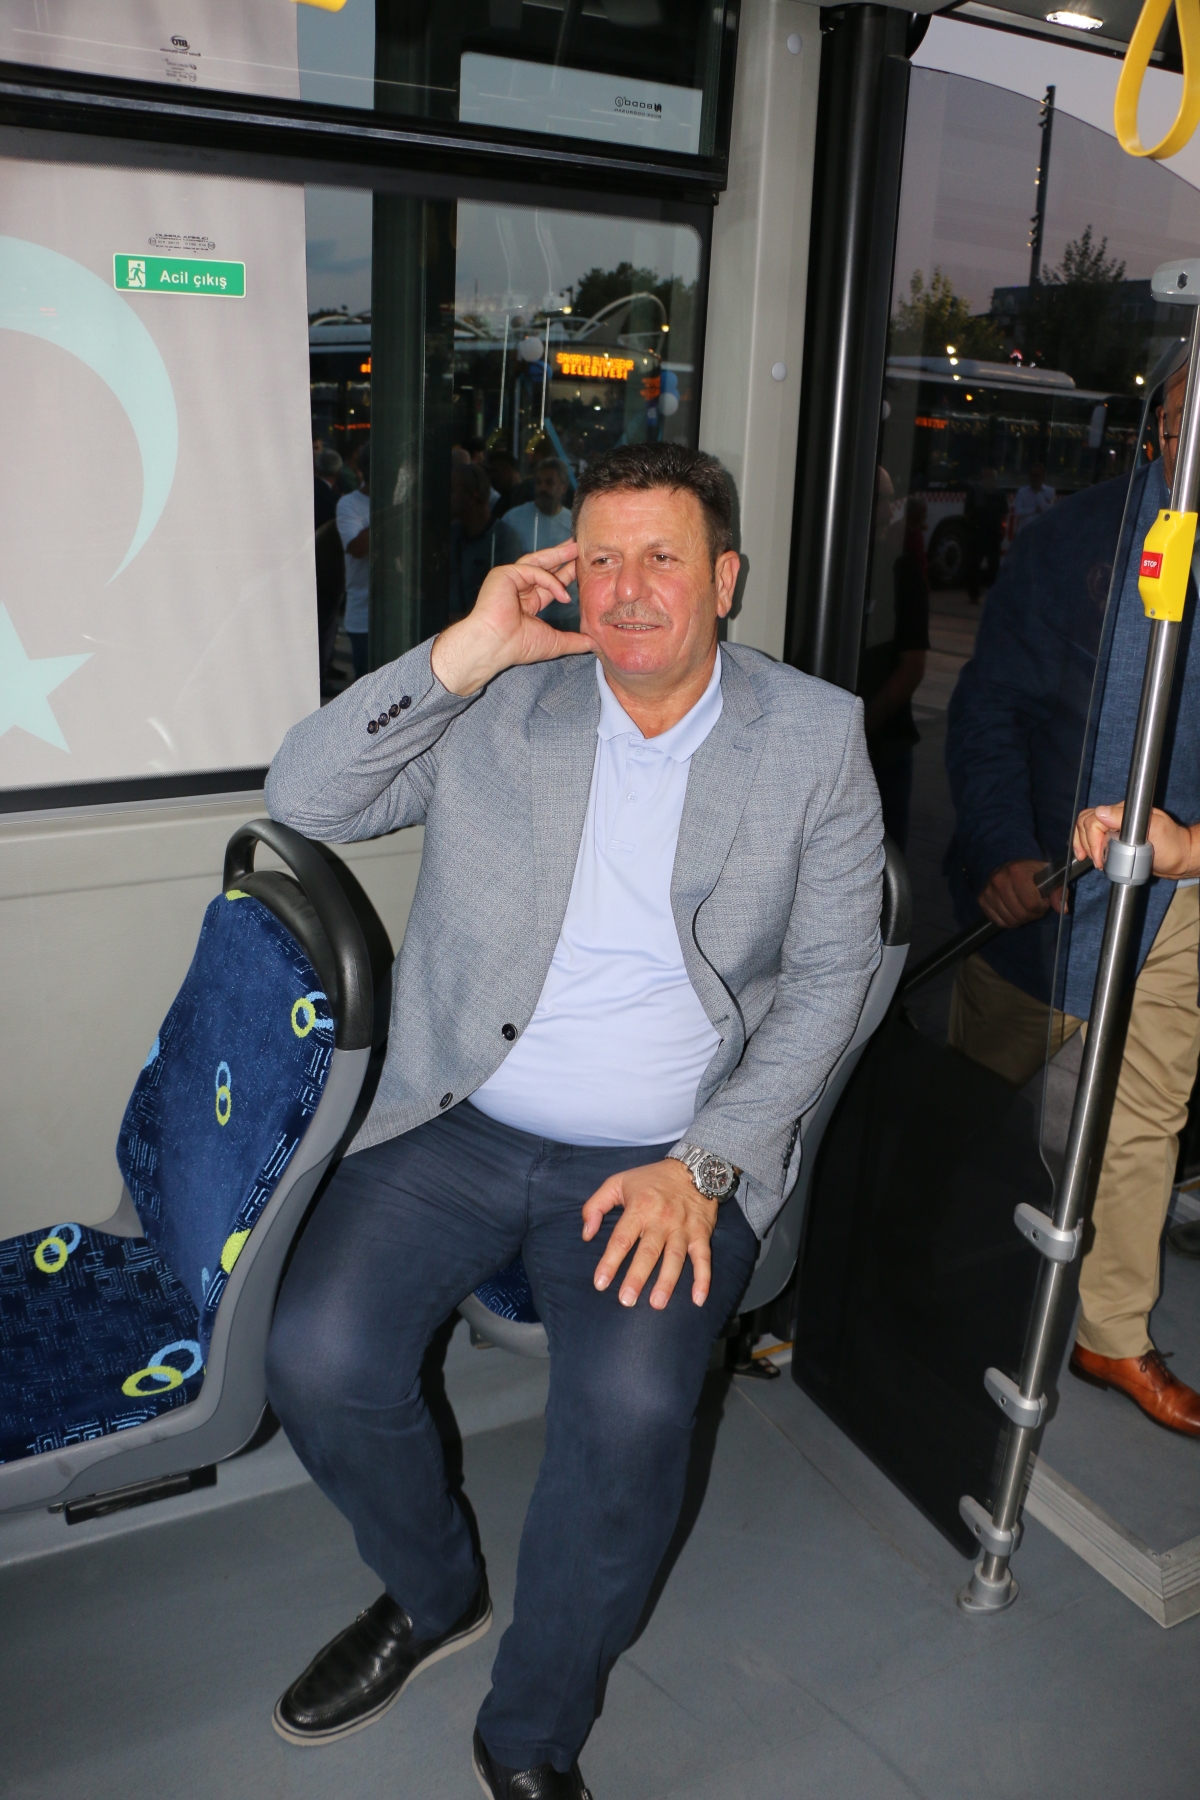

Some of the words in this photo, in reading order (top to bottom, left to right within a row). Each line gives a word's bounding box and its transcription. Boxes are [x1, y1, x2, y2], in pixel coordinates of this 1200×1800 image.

[160, 270, 188, 284] Acil
[193, 273, 227, 290] çıkış
[1143, 559, 1158, 568] STOP
